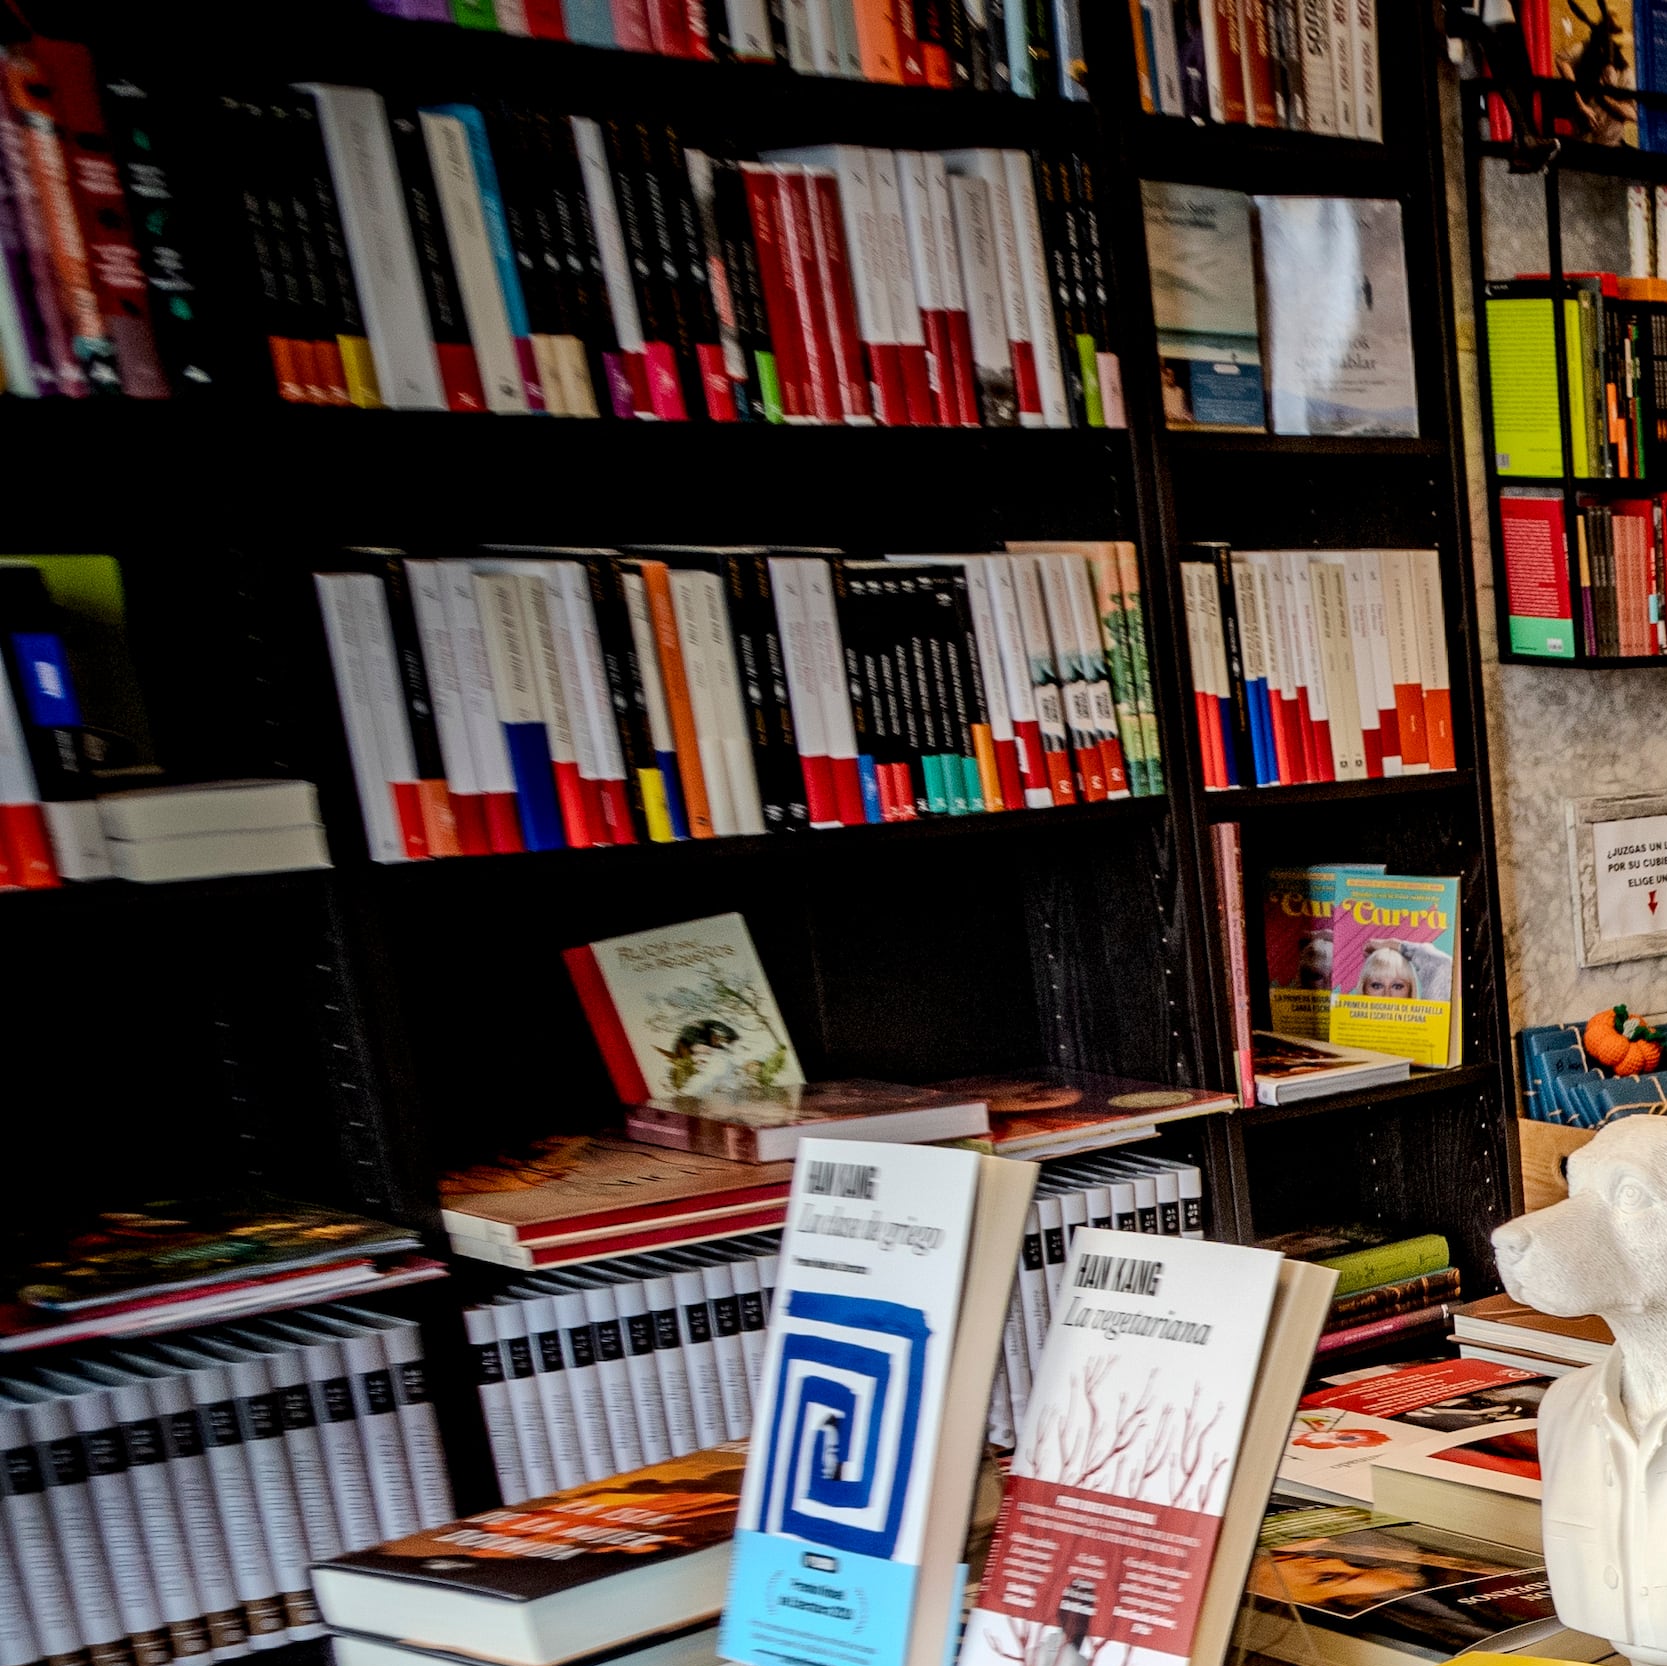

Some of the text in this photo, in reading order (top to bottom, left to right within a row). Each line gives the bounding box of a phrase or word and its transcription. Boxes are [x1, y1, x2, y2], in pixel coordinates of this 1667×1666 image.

[1608, 844, 1646, 859] ¿JUZGAS
[1649, 842, 1662, 852] UN
[1608, 862, 1626, 872] POR
[1629, 860, 1640, 869] SU
[1628, 875, 1655, 887] ELIGE
[1342, 900, 1448, 929] Carrá
[1062, 1296, 1214, 1345] La vegetariana
